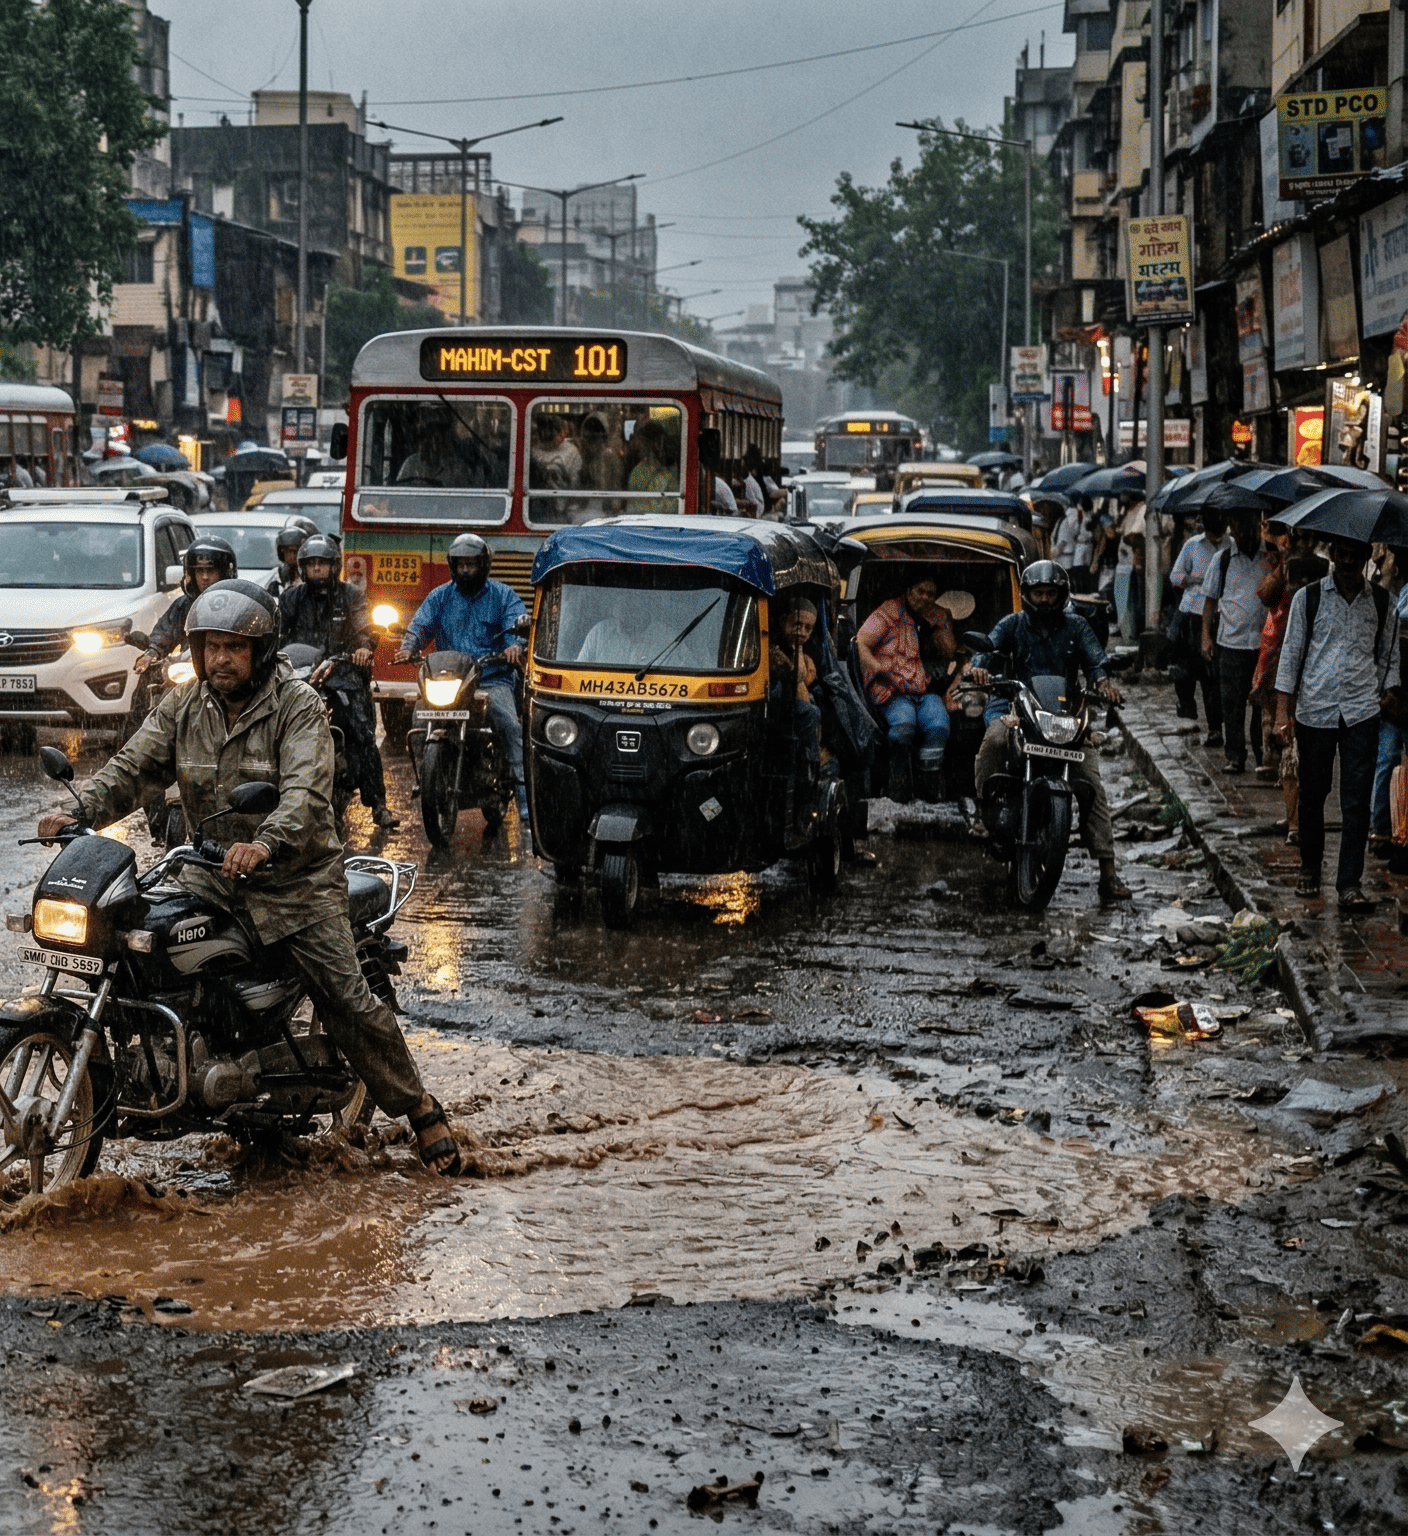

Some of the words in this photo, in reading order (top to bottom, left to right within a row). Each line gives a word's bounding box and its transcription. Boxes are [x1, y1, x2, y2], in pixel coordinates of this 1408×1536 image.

[1286, 97, 1328, 118] STD
[1335, 93, 1379, 115] PCO
[440, 347, 552, 372] MAHIM-CST
[573, 344, 621, 377] 101
[579, 679, 689, 698] MH43AB5678
[178, 926, 206, 943] Hero
